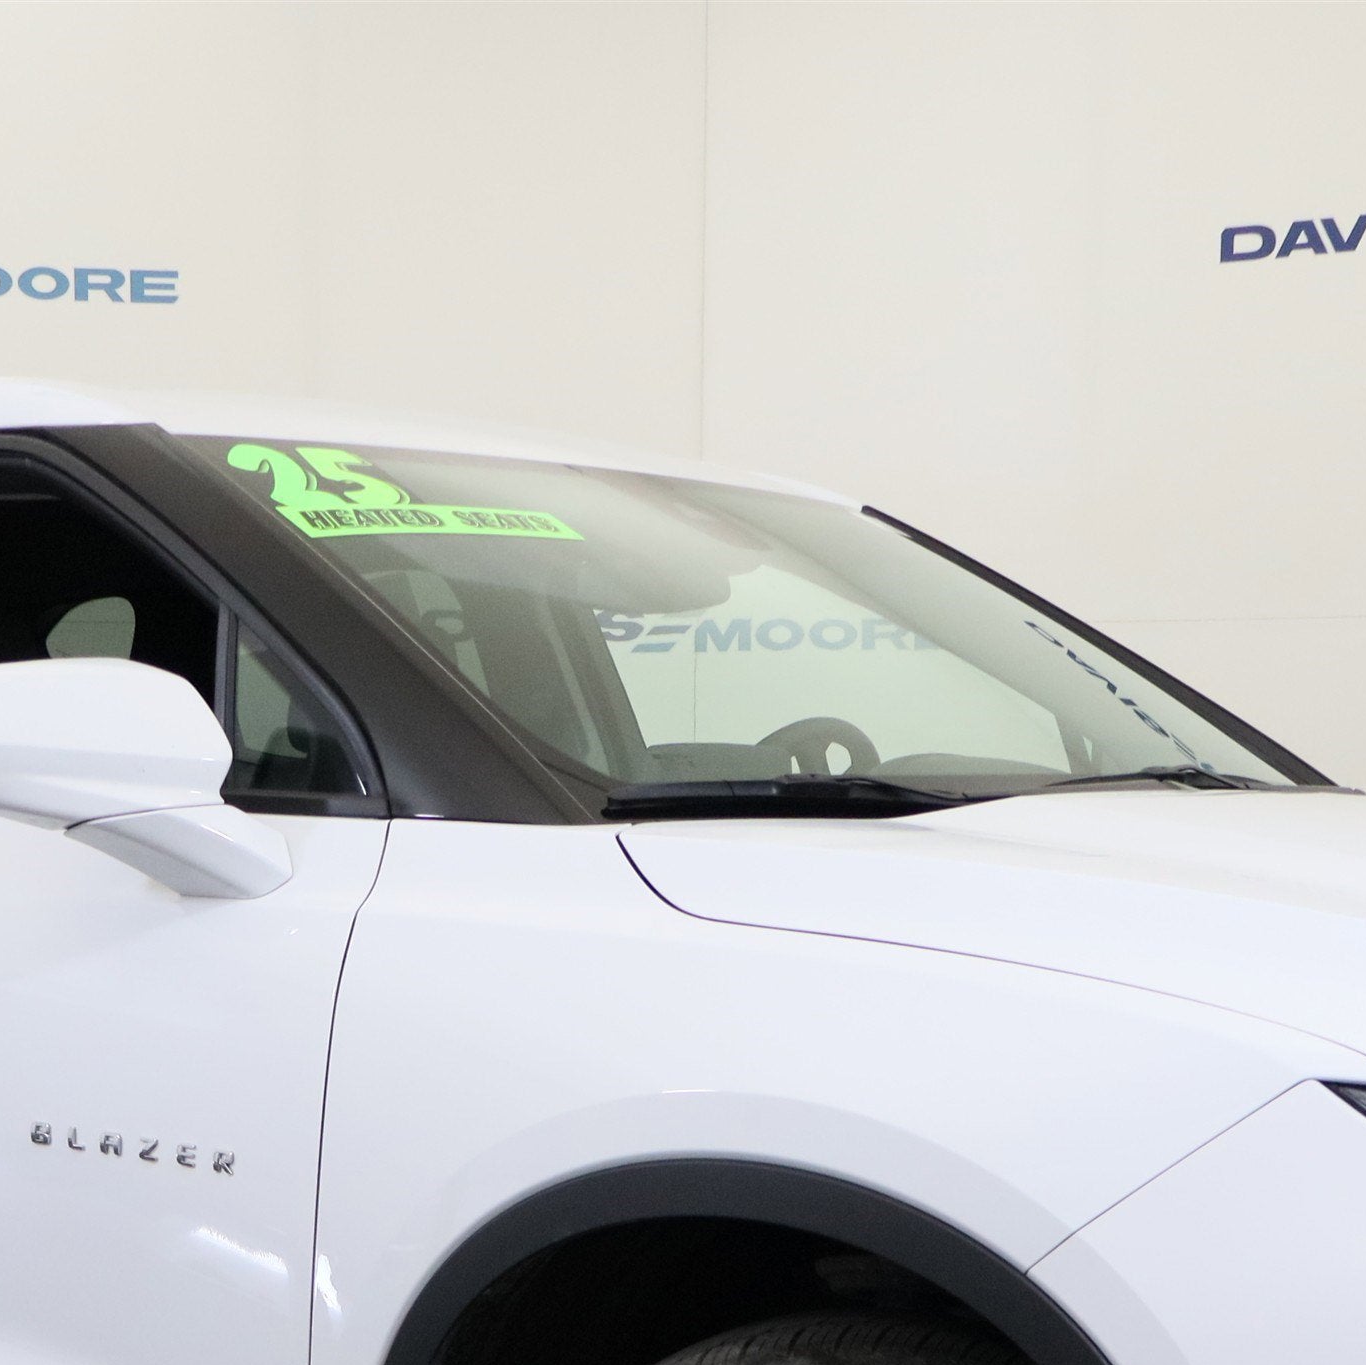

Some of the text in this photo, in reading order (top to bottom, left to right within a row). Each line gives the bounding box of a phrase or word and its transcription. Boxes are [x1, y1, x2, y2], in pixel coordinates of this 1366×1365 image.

[227, 443, 410, 506] 25
[299, 508, 559, 533] HEATED SEATS
[30, 1121, 235, 1176] BLAZER
